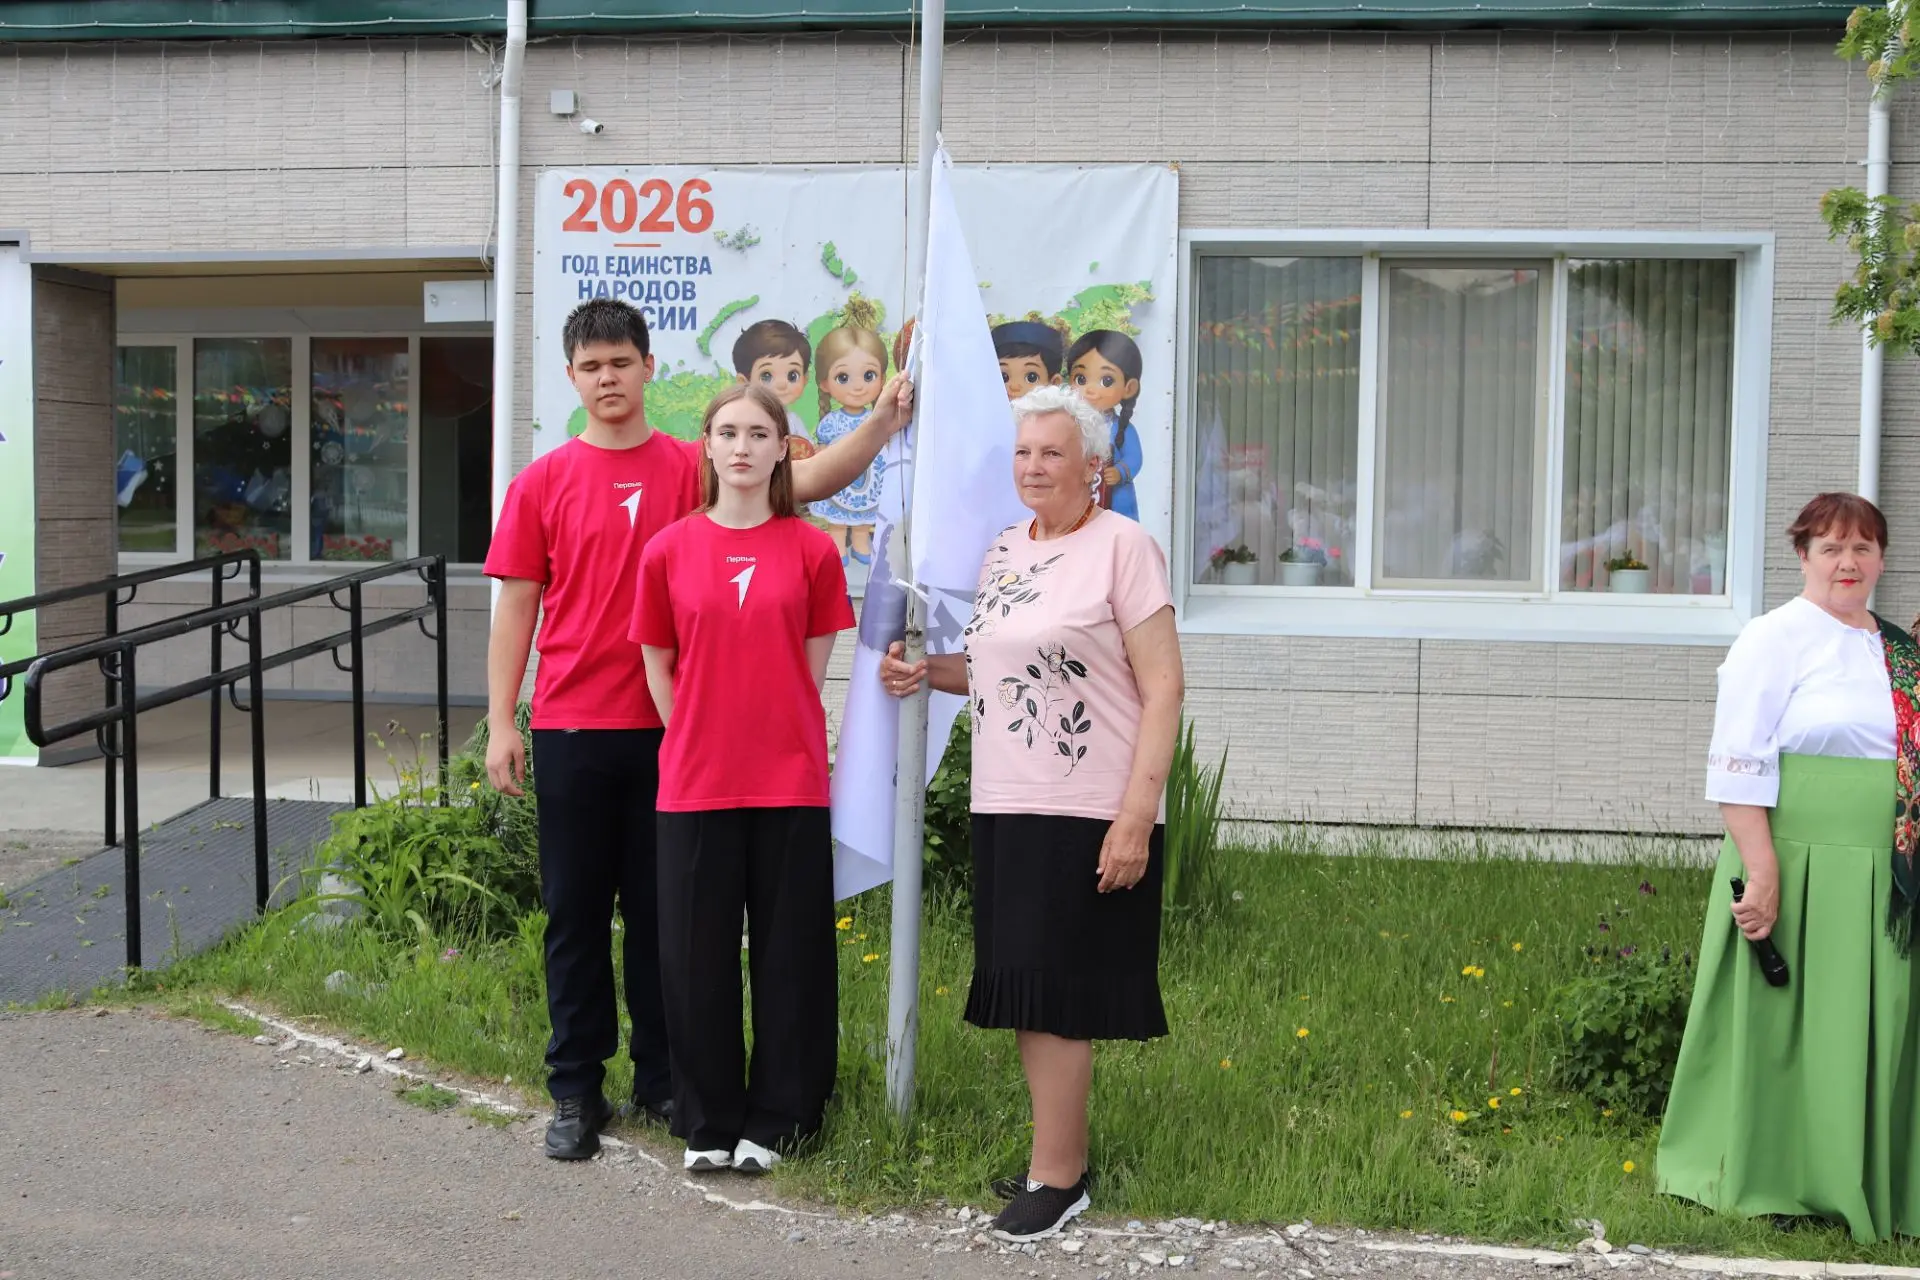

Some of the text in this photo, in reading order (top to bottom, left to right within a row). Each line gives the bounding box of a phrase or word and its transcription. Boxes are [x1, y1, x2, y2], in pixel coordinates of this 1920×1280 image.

[562, 178, 714, 233] 2026
[562, 255, 712, 277] ГОД ЕДИНСТВА
[578, 280, 697, 303] НАРОДОВ
[640, 306, 697, 330] СИИ
